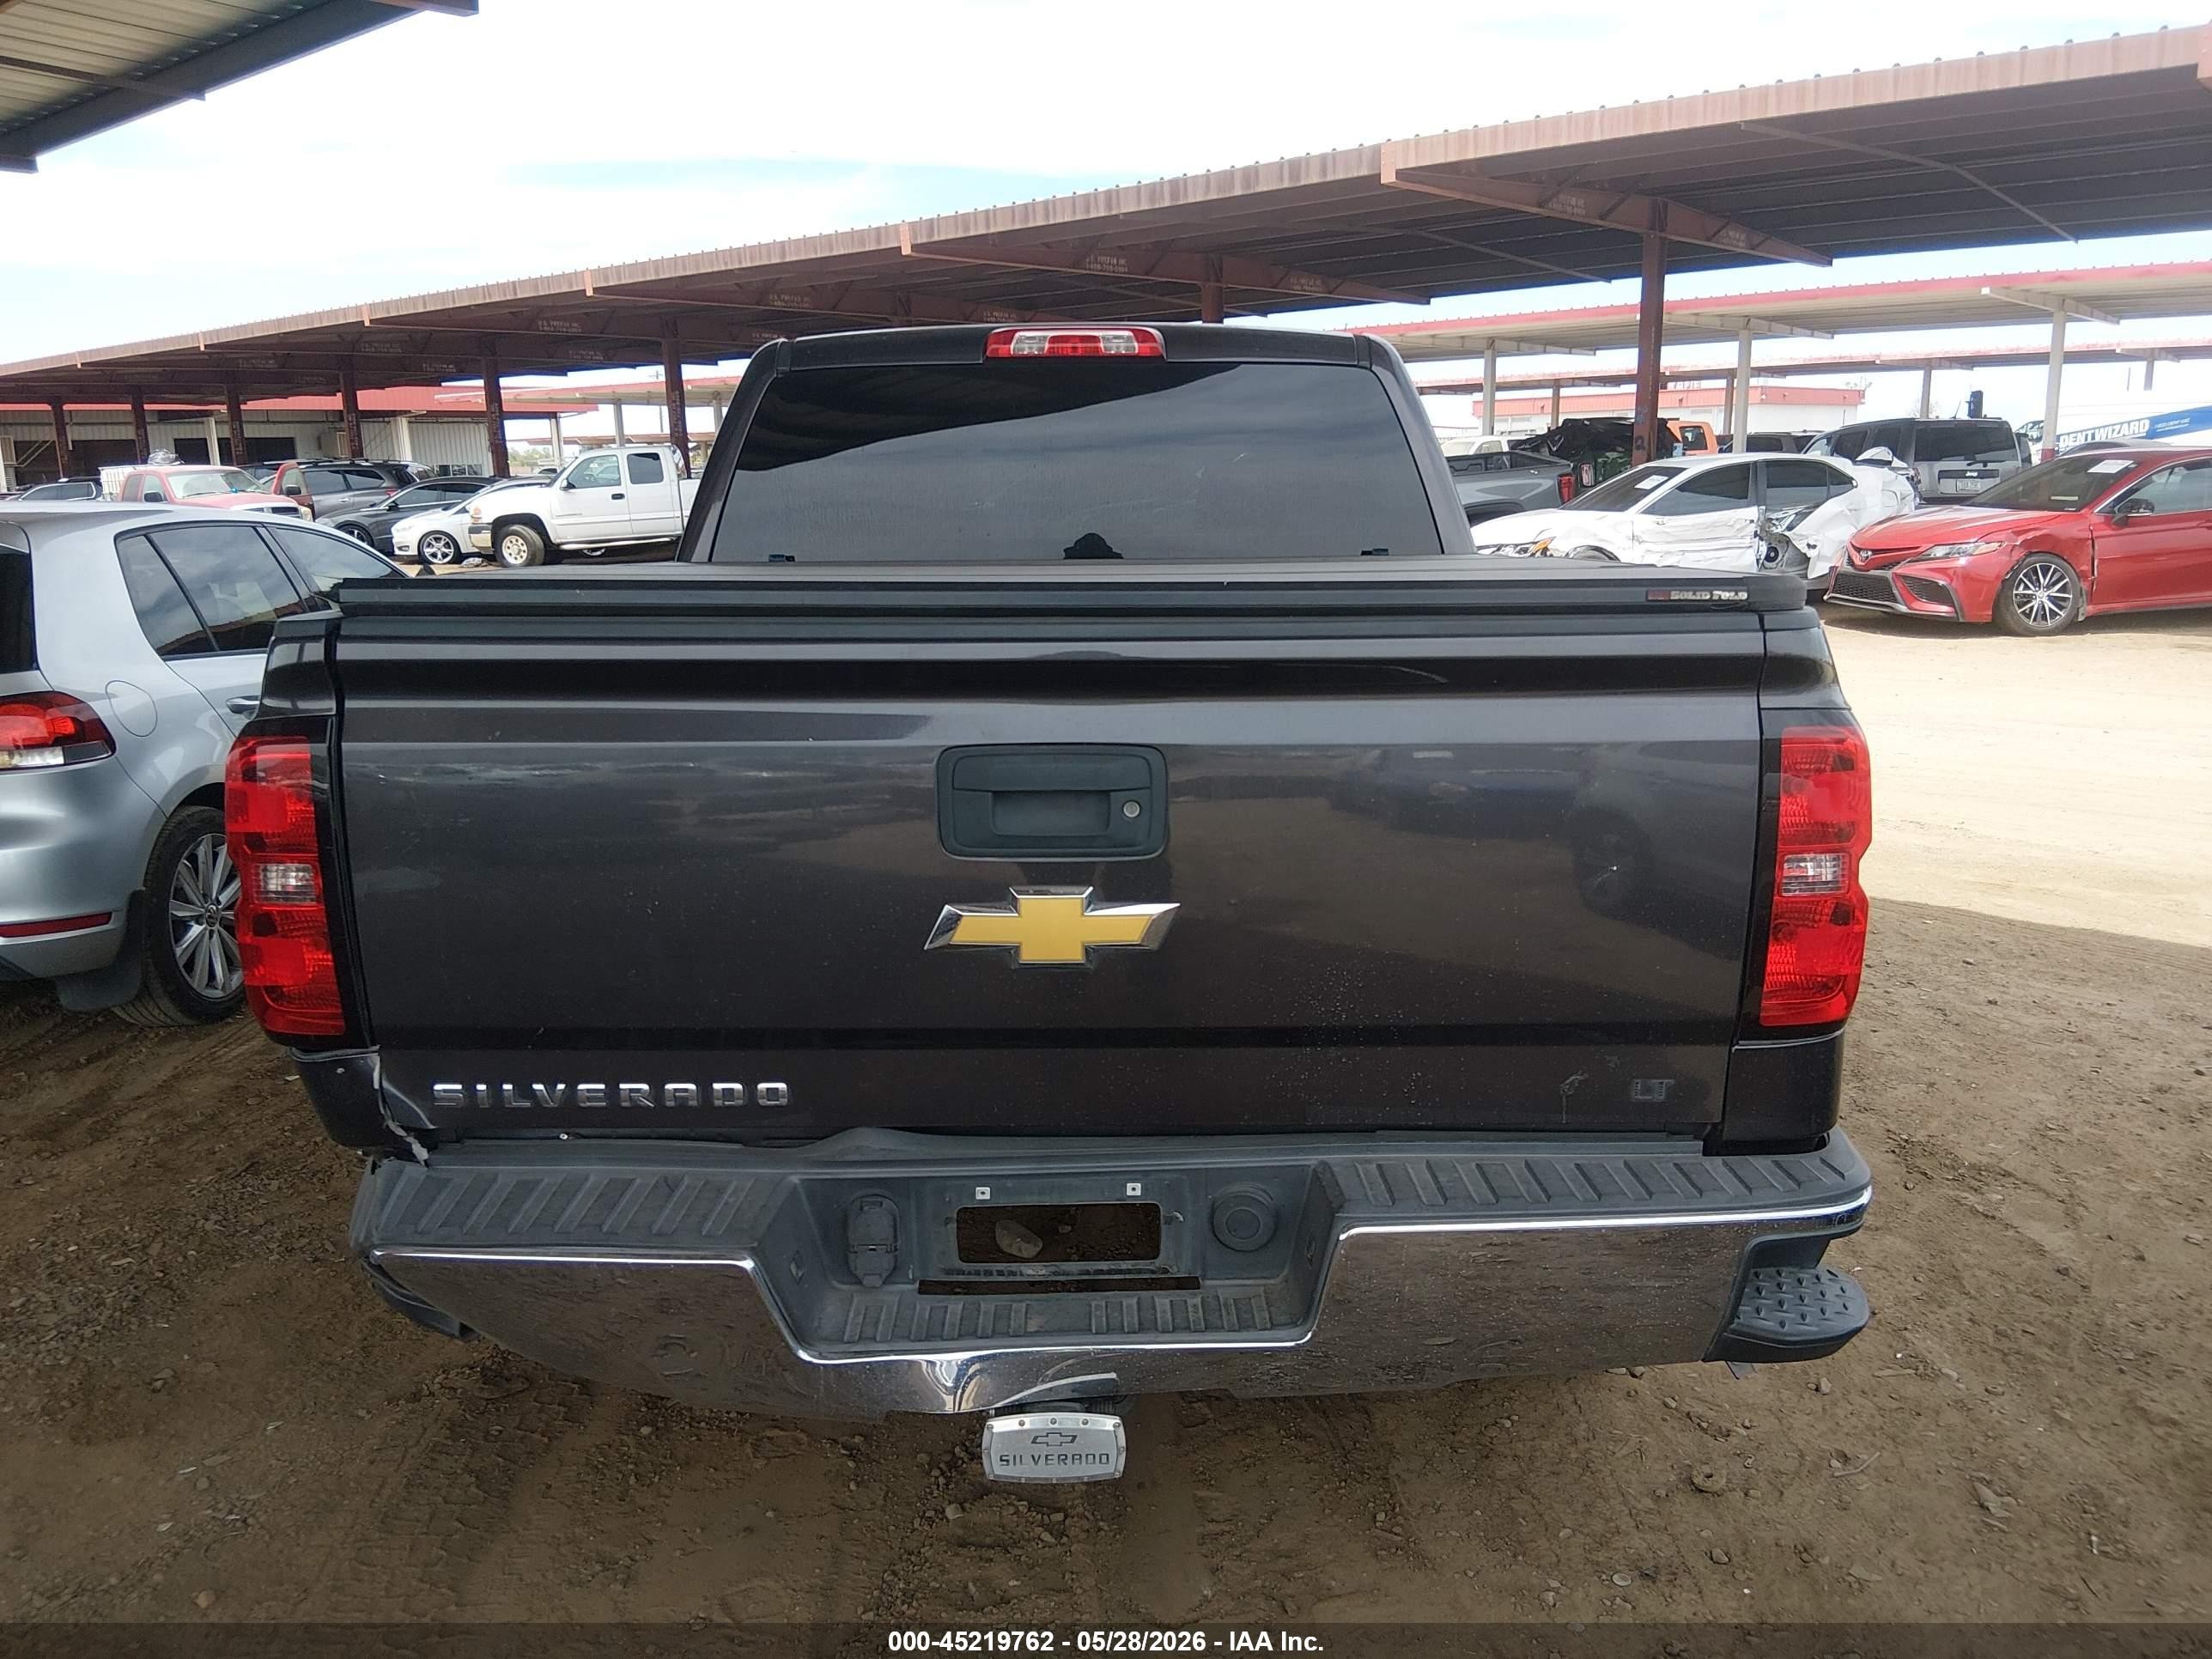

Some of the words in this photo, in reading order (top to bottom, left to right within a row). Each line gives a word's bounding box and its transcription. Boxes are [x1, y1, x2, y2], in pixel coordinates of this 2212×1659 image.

[1670, 590, 1711, 600] SOLID
[432, 1081, 792, 1109] SILVERADO
[1634, 1079, 1675, 1100] LT
[1000, 1453, 1109, 1467] SILVERADO
